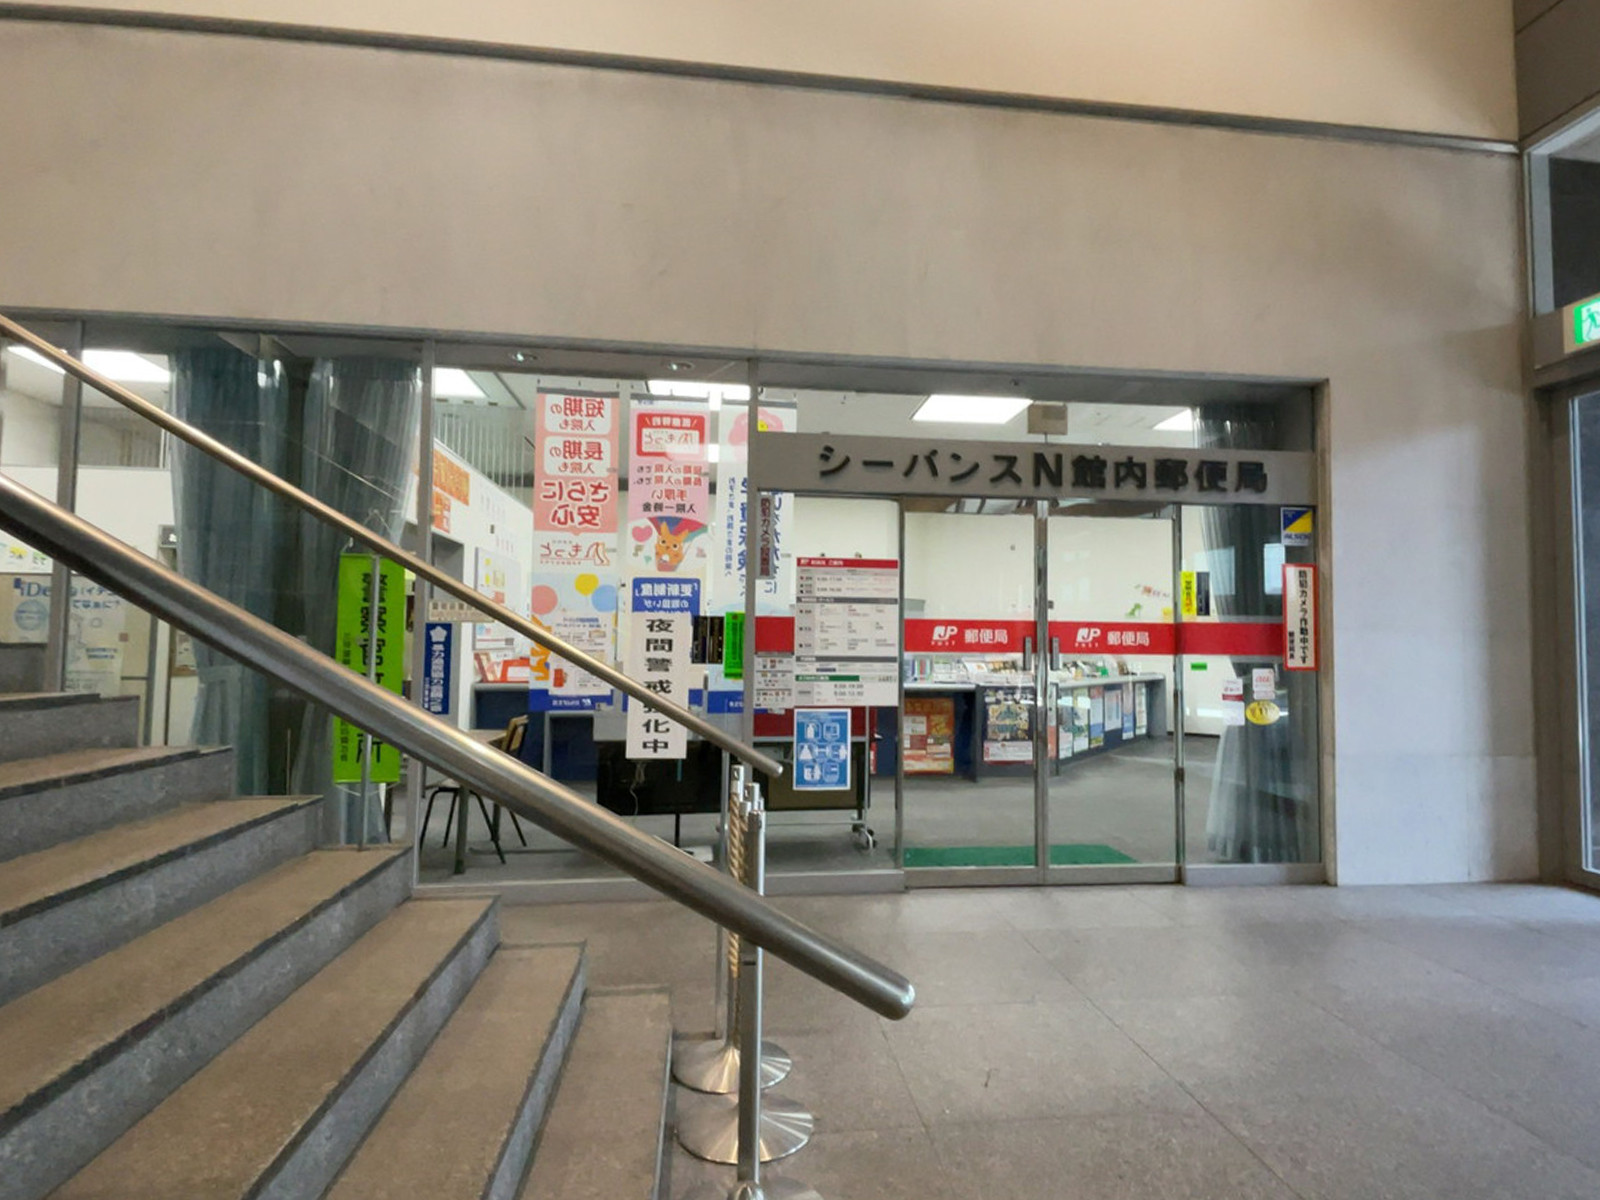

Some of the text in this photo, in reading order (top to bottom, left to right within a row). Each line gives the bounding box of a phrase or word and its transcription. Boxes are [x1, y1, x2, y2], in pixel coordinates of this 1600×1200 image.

[819, 445, 1268, 493] シーバンスN館内郵便局
[965, 629, 1008, 644] 郵便局
[1107, 631, 1150, 646] 郵便局
